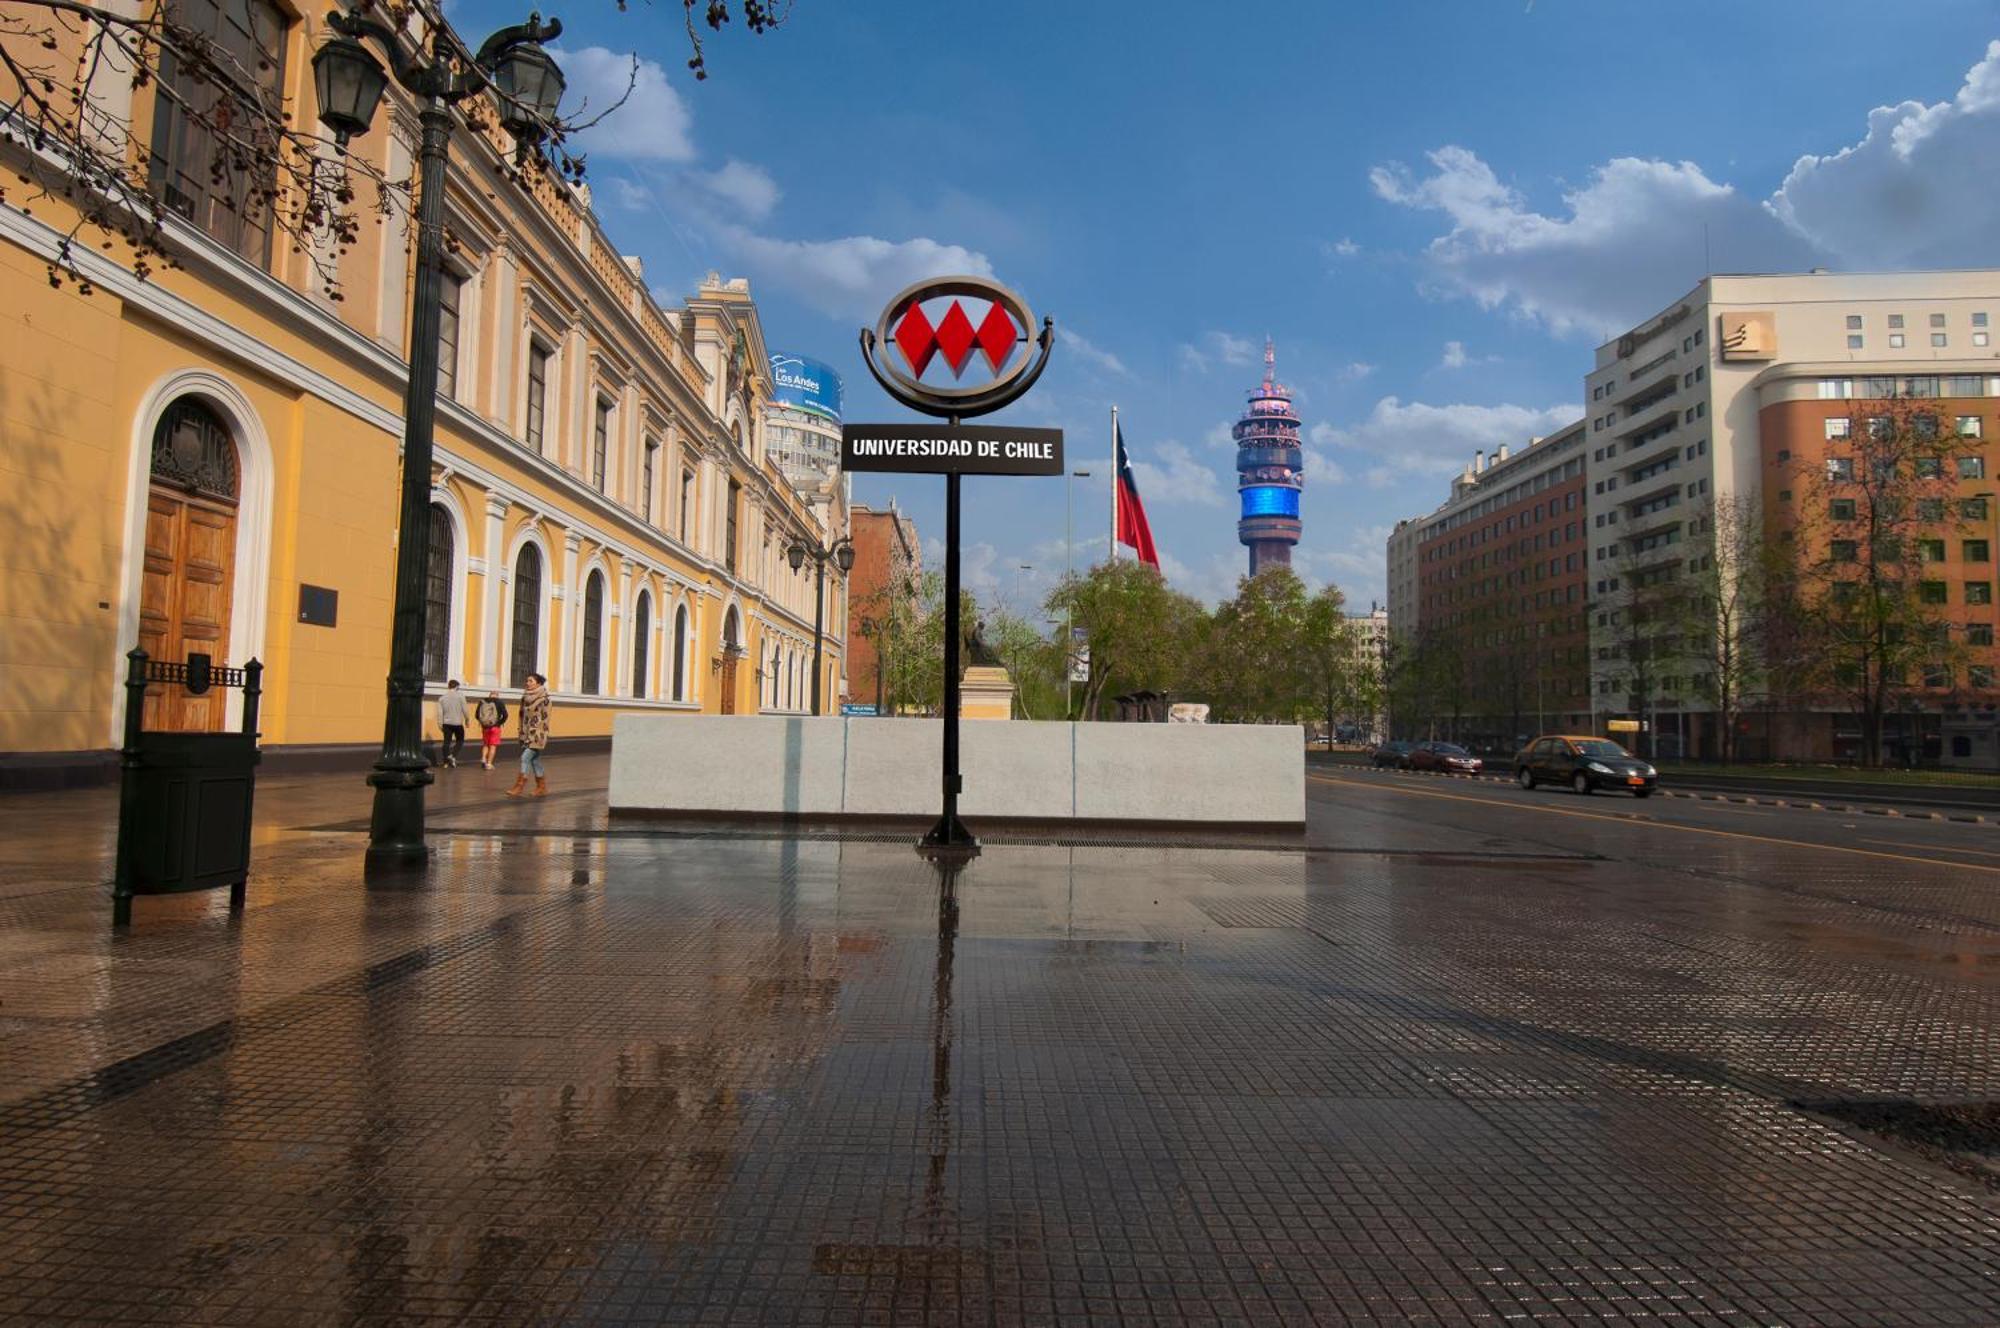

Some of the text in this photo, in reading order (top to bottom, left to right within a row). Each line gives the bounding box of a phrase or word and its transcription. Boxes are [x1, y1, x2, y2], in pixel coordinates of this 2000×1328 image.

[775, 367, 793, 384] Los
[793, 375, 820, 391] Andes
[852, 439, 1054, 459] UNIVERSIDAD DE CHILE
